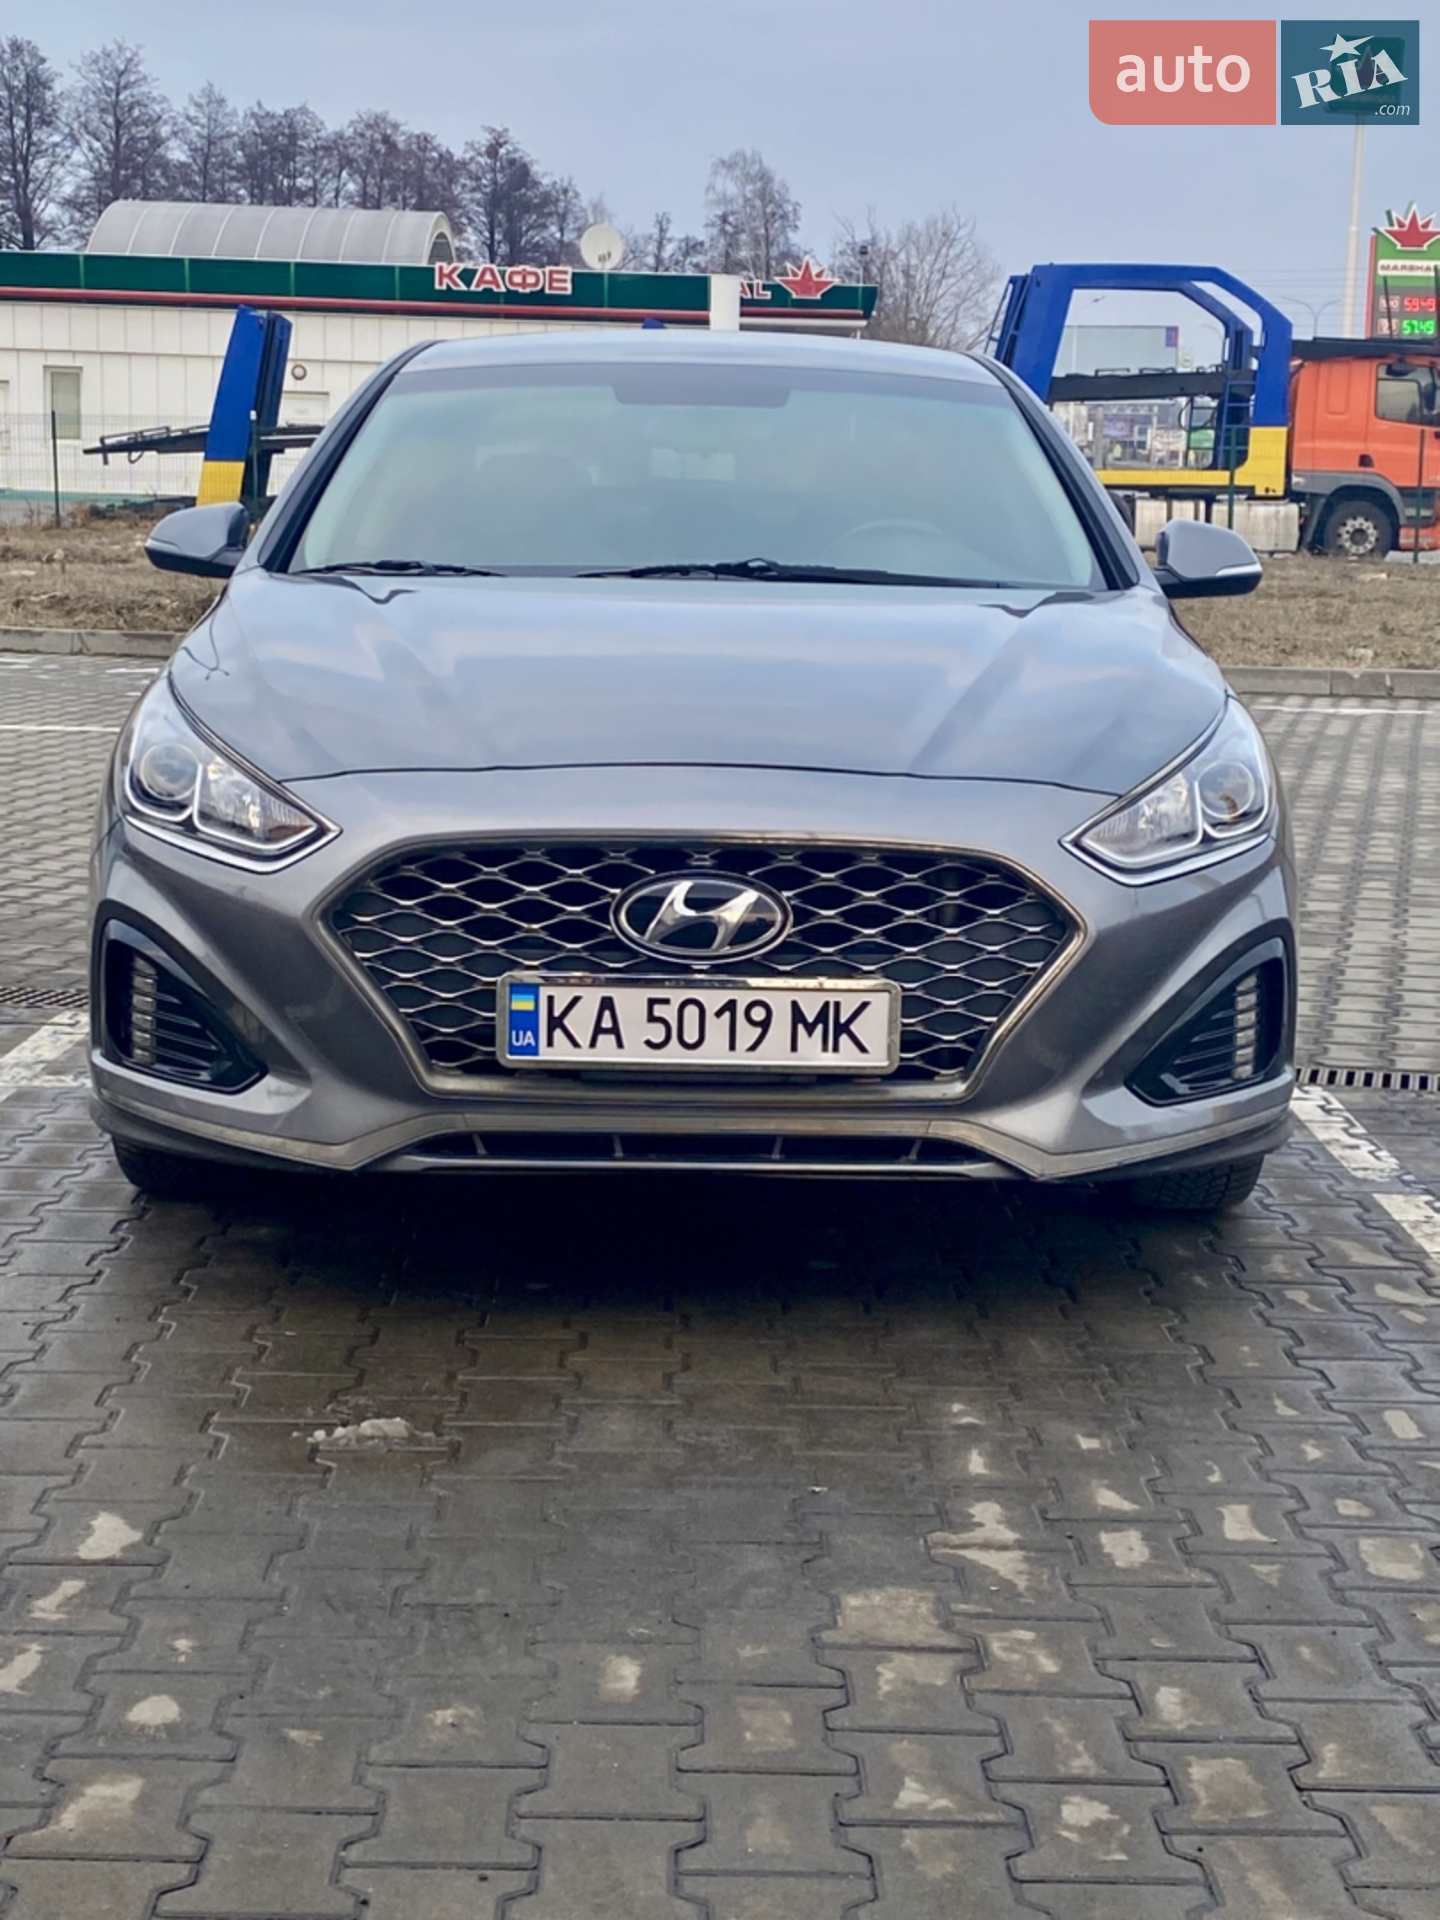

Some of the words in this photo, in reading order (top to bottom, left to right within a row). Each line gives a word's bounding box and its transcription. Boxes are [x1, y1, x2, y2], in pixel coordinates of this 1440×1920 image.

[435, 262, 572, 295] КАФЕ
[1380, 264, 1434, 273] MARSHA
[546, 994, 625, 1049] KA
[643, 997, 774, 1053] 5019
[790, 999, 872, 1054] MK
[511, 1031, 536, 1047] UA
